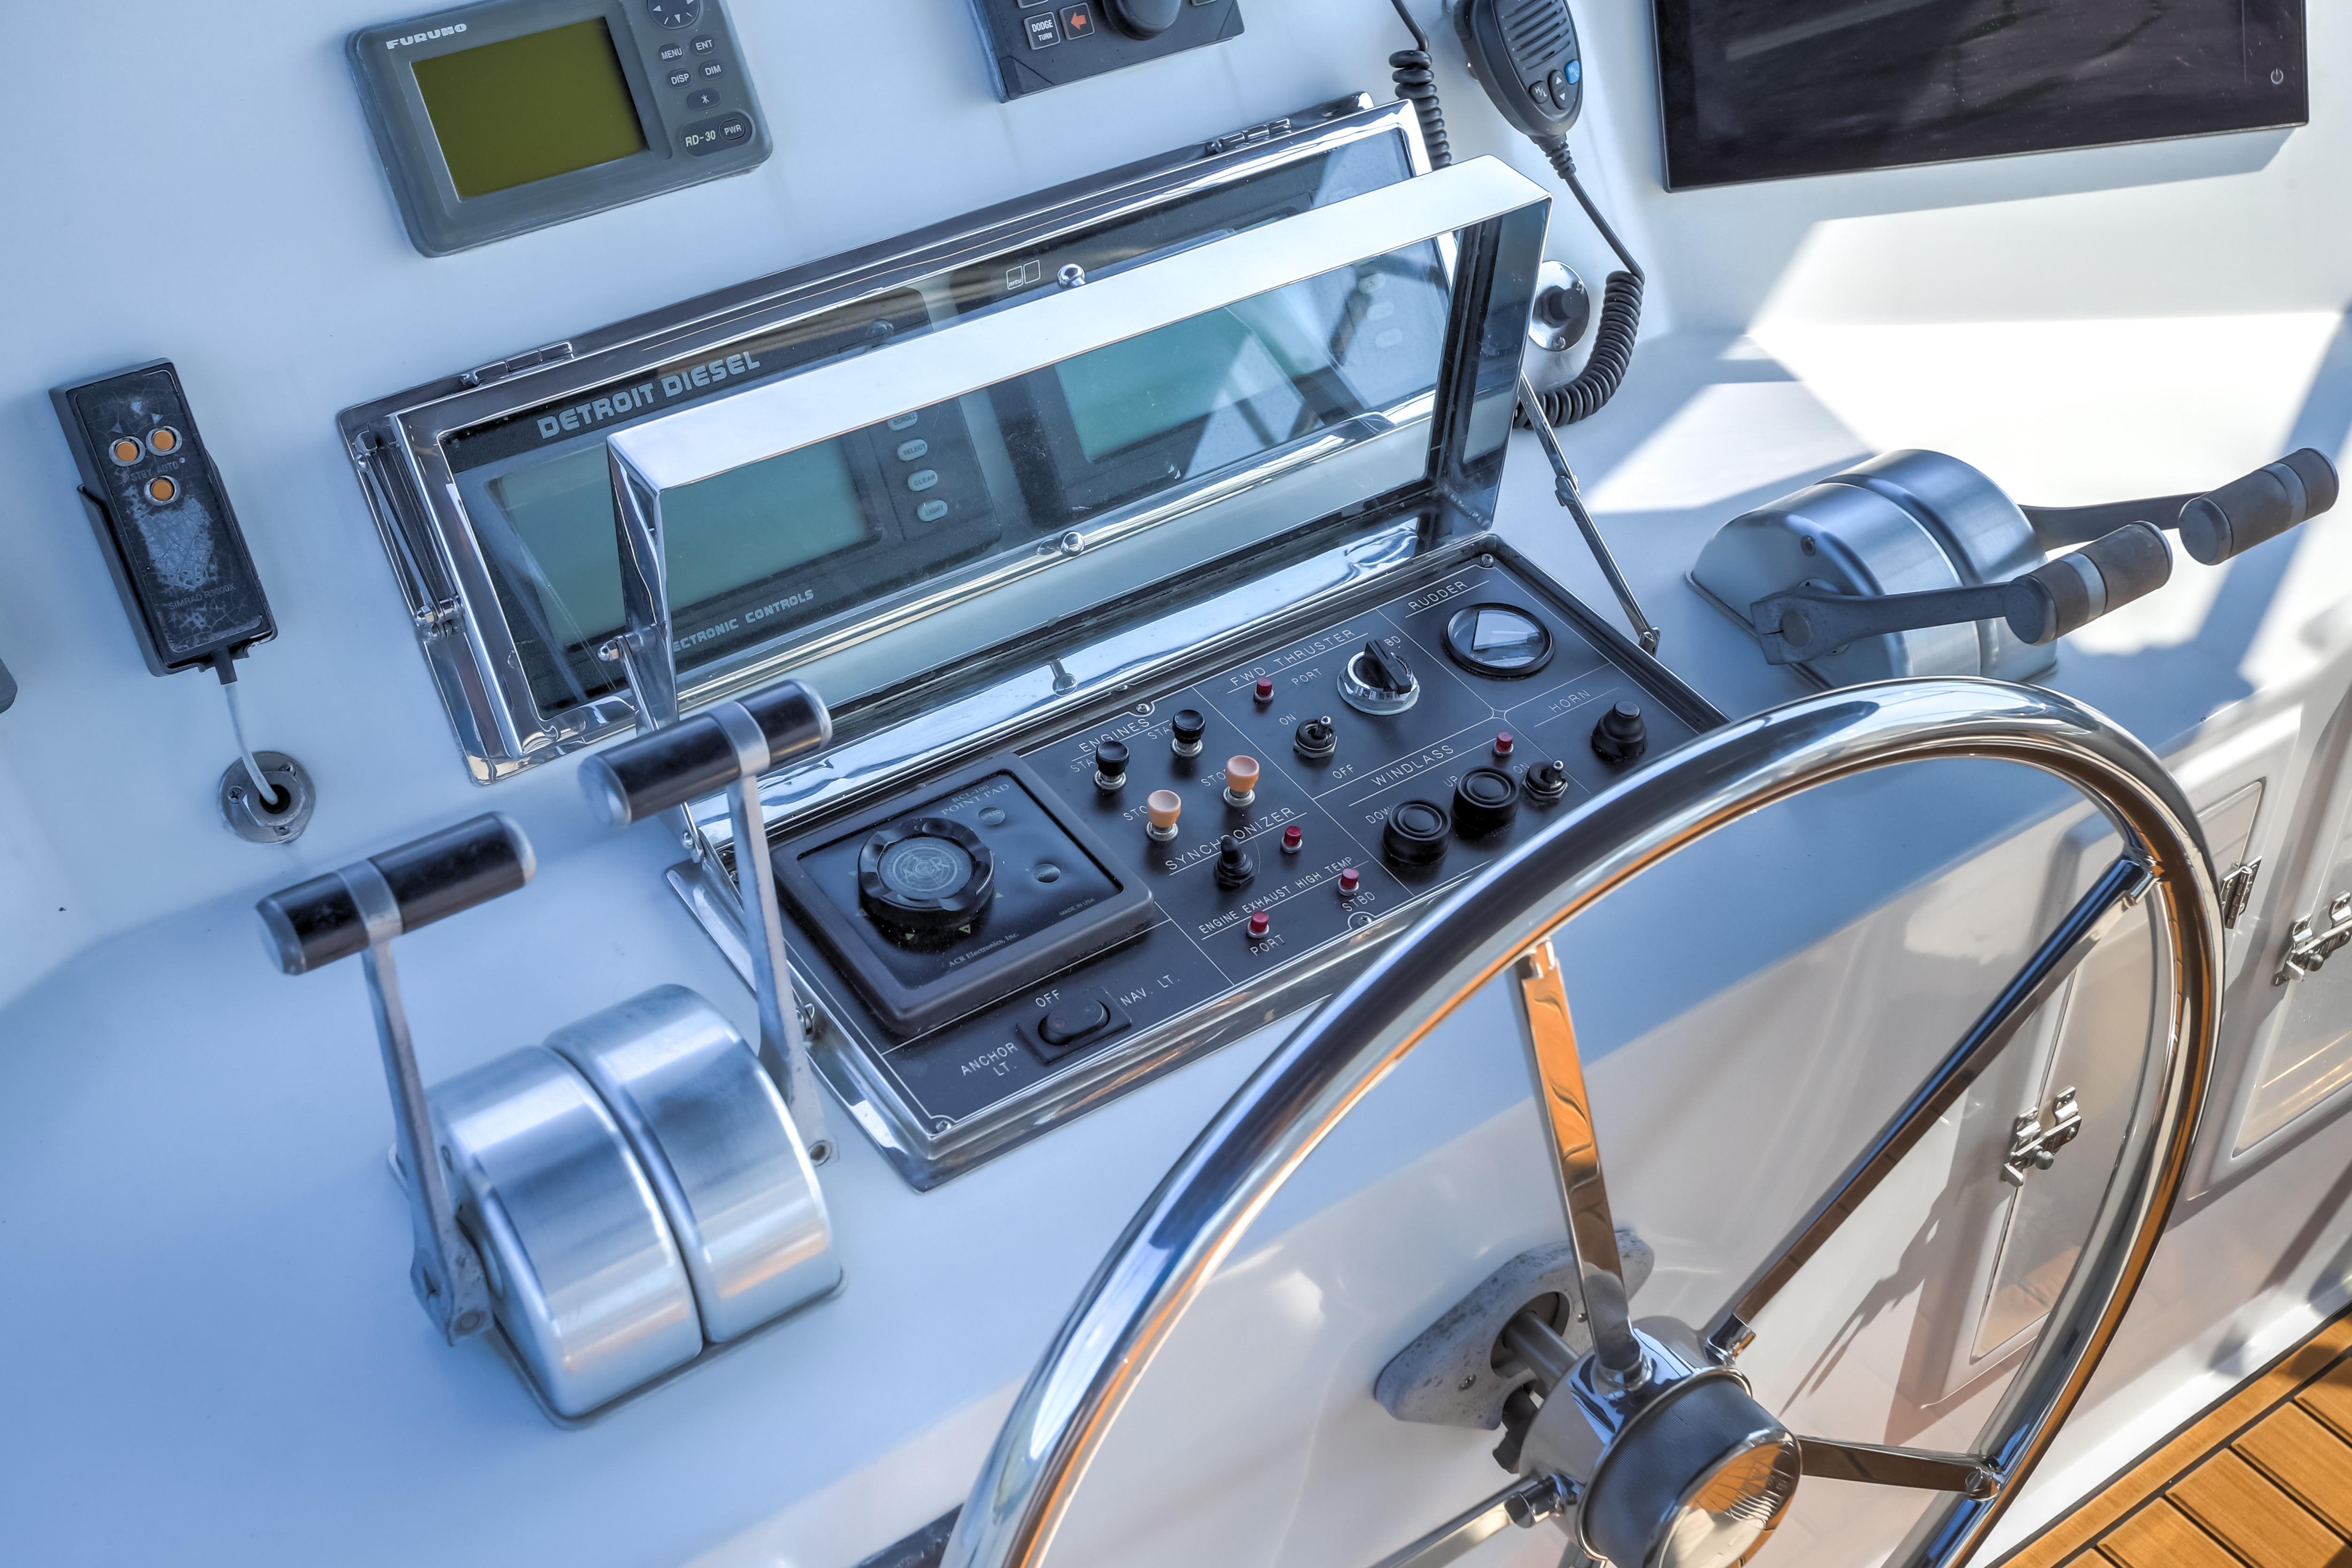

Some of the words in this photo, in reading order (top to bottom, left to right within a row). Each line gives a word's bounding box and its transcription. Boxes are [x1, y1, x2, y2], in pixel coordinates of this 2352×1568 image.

[1031, 19, 1054, 32] DODGE
[386, 23, 467, 50] FURUNO
[1038, 32, 1053, 41] TURN
[695, 39, 713, 51] ENT
[661, 47, 682, 60] MENU
[705, 65, 721, 76] DIM
[671, 73, 689, 85] DISP
[1535, 86, 1547, 97] H/L
[686, 130, 716, 147] RD-30
[724, 124, 741, 135] PWR
[1009, 278, 1022, 287] mtu
[536, 383, 654, 440] DETROIT
[661, 351, 760, 398] DIESEL
[893, 411, 917, 425] SCROLL
[903, 444, 926, 456] SELECT
[156, 461, 179, 474] AUTO
[914, 475, 936, 486] CLEAR
[925, 505, 944, 516] LIGHT
[169, 594, 202, 610] SIMRAD
[1408, 581, 1468, 611] RUDDER
[673, 618, 739, 652] ECTRONIC
[745, 589, 814, 624] CONTROLS
[1230, 667, 1266, 686] FWD
[1273, 629, 1355, 667] THRUSTER
[1291, 668, 1322, 686] PORT
[1548, 689, 1591, 713] HORN
[1279, 714, 1296, 725] ON
[1148, 723, 1172, 740] STA
[1070, 756, 1096, 772] STA
[1332, 765, 1354, 779] OFF
[1371, 745, 1454, 786] WINDLASS
[1513, 762, 1530, 774] ON
[1201, 769, 1227, 787] STO
[1443, 776, 1458, 788] UP
[941, 795, 980, 815] POINT
[984, 784, 1009, 797] PAD
[951, 785, 989, 803] RCL-100
[980, 810, 1001, 820] SPEED
[1123, 806, 1147, 821] STO
[1365, 804, 1392, 824] DOW
[1035, 867, 1059, 880] POWER
[1199, 911, 1239, 934] ENGINE
[1242, 886, 1291, 913] EXHAUST
[1295, 872, 1323, 888] HIGH
[1324, 857, 1352, 874] TEMP
[1342, 891, 1375, 911] STBD
[1059, 905, 1076, 916] MADE
[949, 956, 966, 967] ACR
[965, 939, 1005, 959] Electronics,
[1005, 932, 1019, 941] Inc.
[1250, 934, 1285, 957] PORT
[1035, 989, 1060, 1008] OFF
[960, 1042, 1018, 1076] ANCHOR
